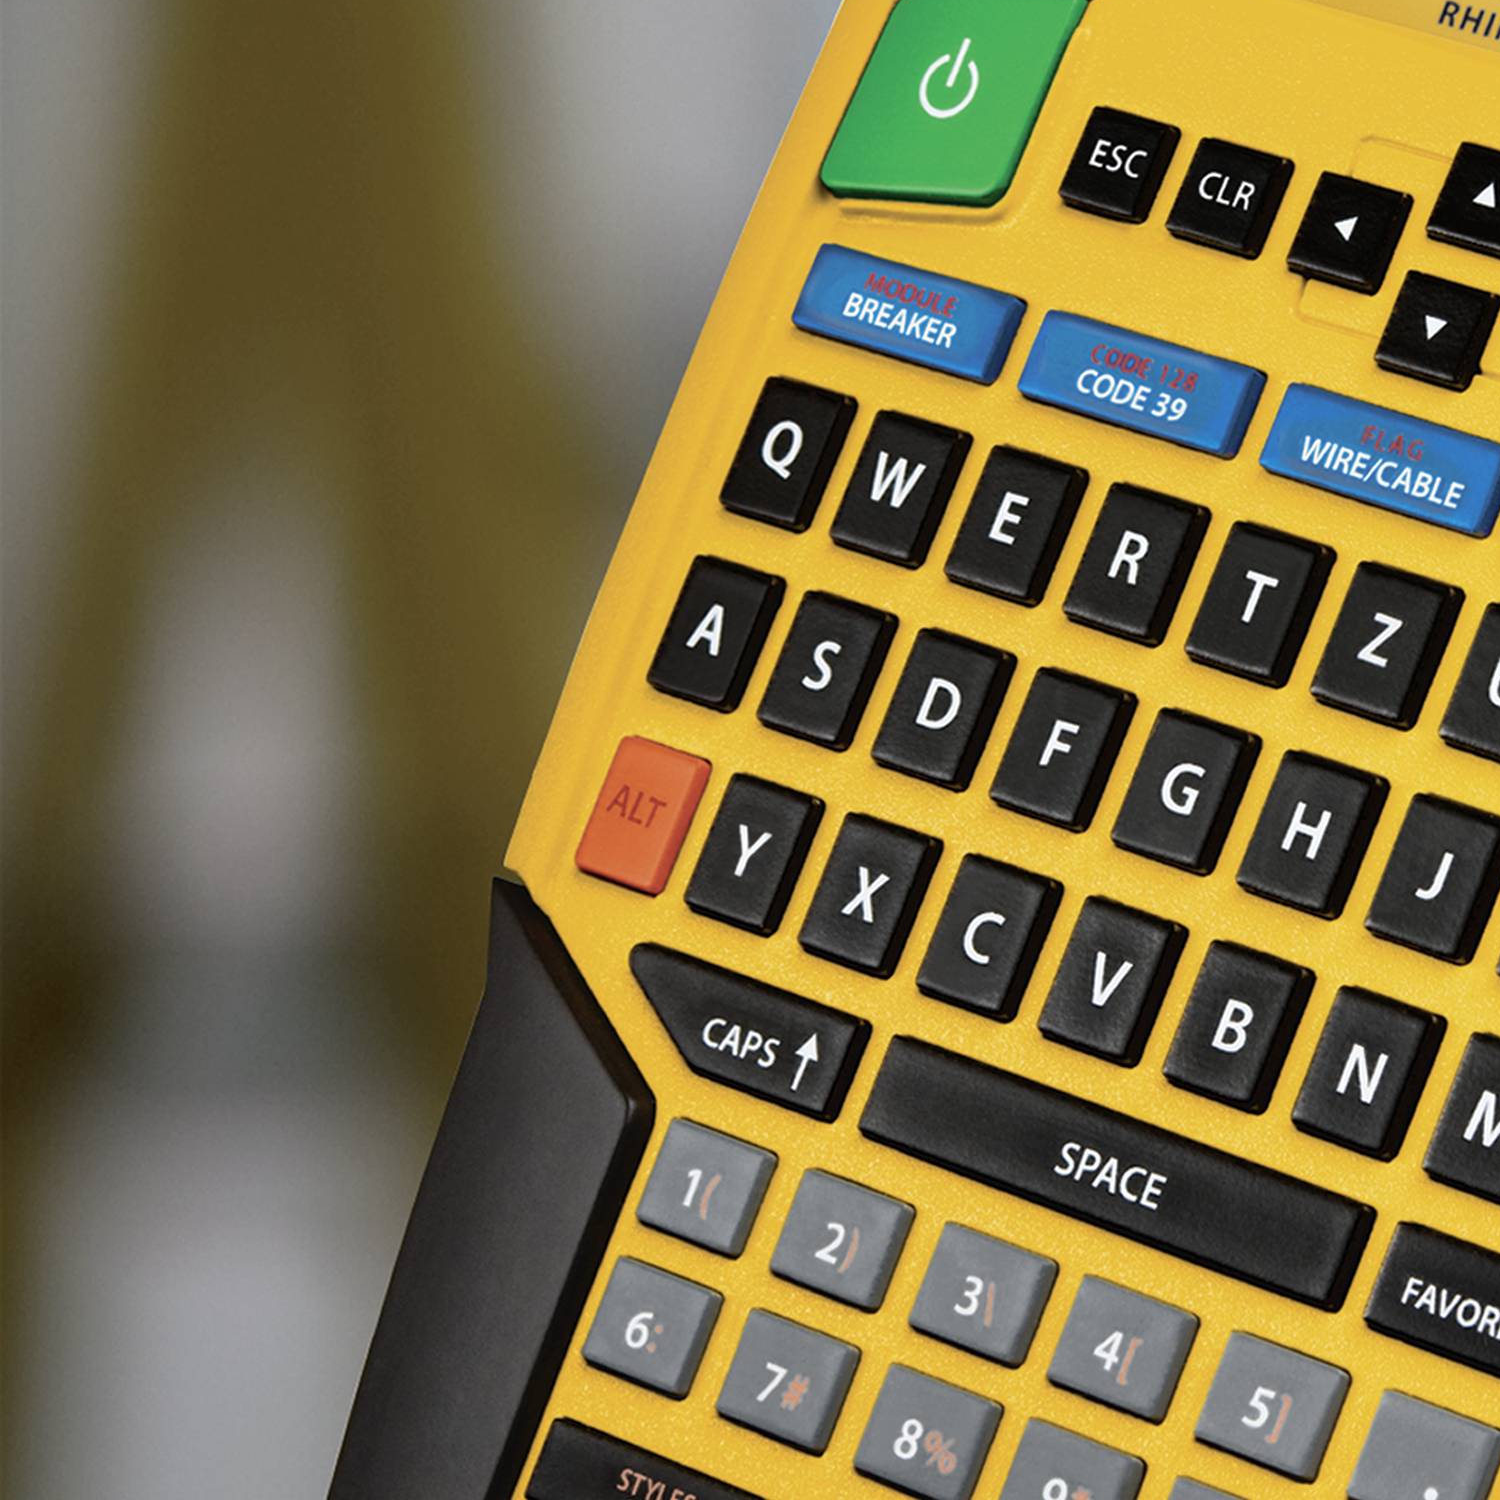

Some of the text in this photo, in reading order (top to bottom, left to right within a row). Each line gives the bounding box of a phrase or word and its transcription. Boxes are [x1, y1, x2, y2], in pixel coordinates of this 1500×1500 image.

[1089, 139, 1147, 179] ESC
[1198, 171, 1256, 211] CLR
[843, 292, 957, 348] BREAKER
[863, 272, 958, 318] MODULE
[1091, 343, 1200, 393] CODE 128
[1076, 369, 1188, 422] CODE 39
[762, 421, 803, 479] Q
[1362, 425, 1425, 462] FLAG
[871, 451, 926, 508] W
[1301, 435, 1466, 509] WIRE/CABLE
[989, 491, 1029, 545] E
[1108, 530, 1149, 585] R
[1242, 570, 1279, 623] T
[686, 604, 724, 656] A
[1357, 612, 1403, 667] Z
[802, 640, 841, 690] S
[916, 677, 961, 729] D
[1039, 719, 1080, 766] F
[605, 784, 667, 829] ALT
[1161, 763, 1206, 815] G
[734, 824, 772, 877] Y
[1281, 801, 1332, 860] H
[841, 866, 890, 923] X
[1415, 852, 1454, 900] J
[963, 911, 1006, 964] C
[1092, 951, 1133, 1006] V
[703, 1018, 780, 1068] CAPS
[1211, 999, 1254, 1052] B
[1336, 1043, 1389, 1104] N
[1054, 1142, 1167, 1210] SPACE
